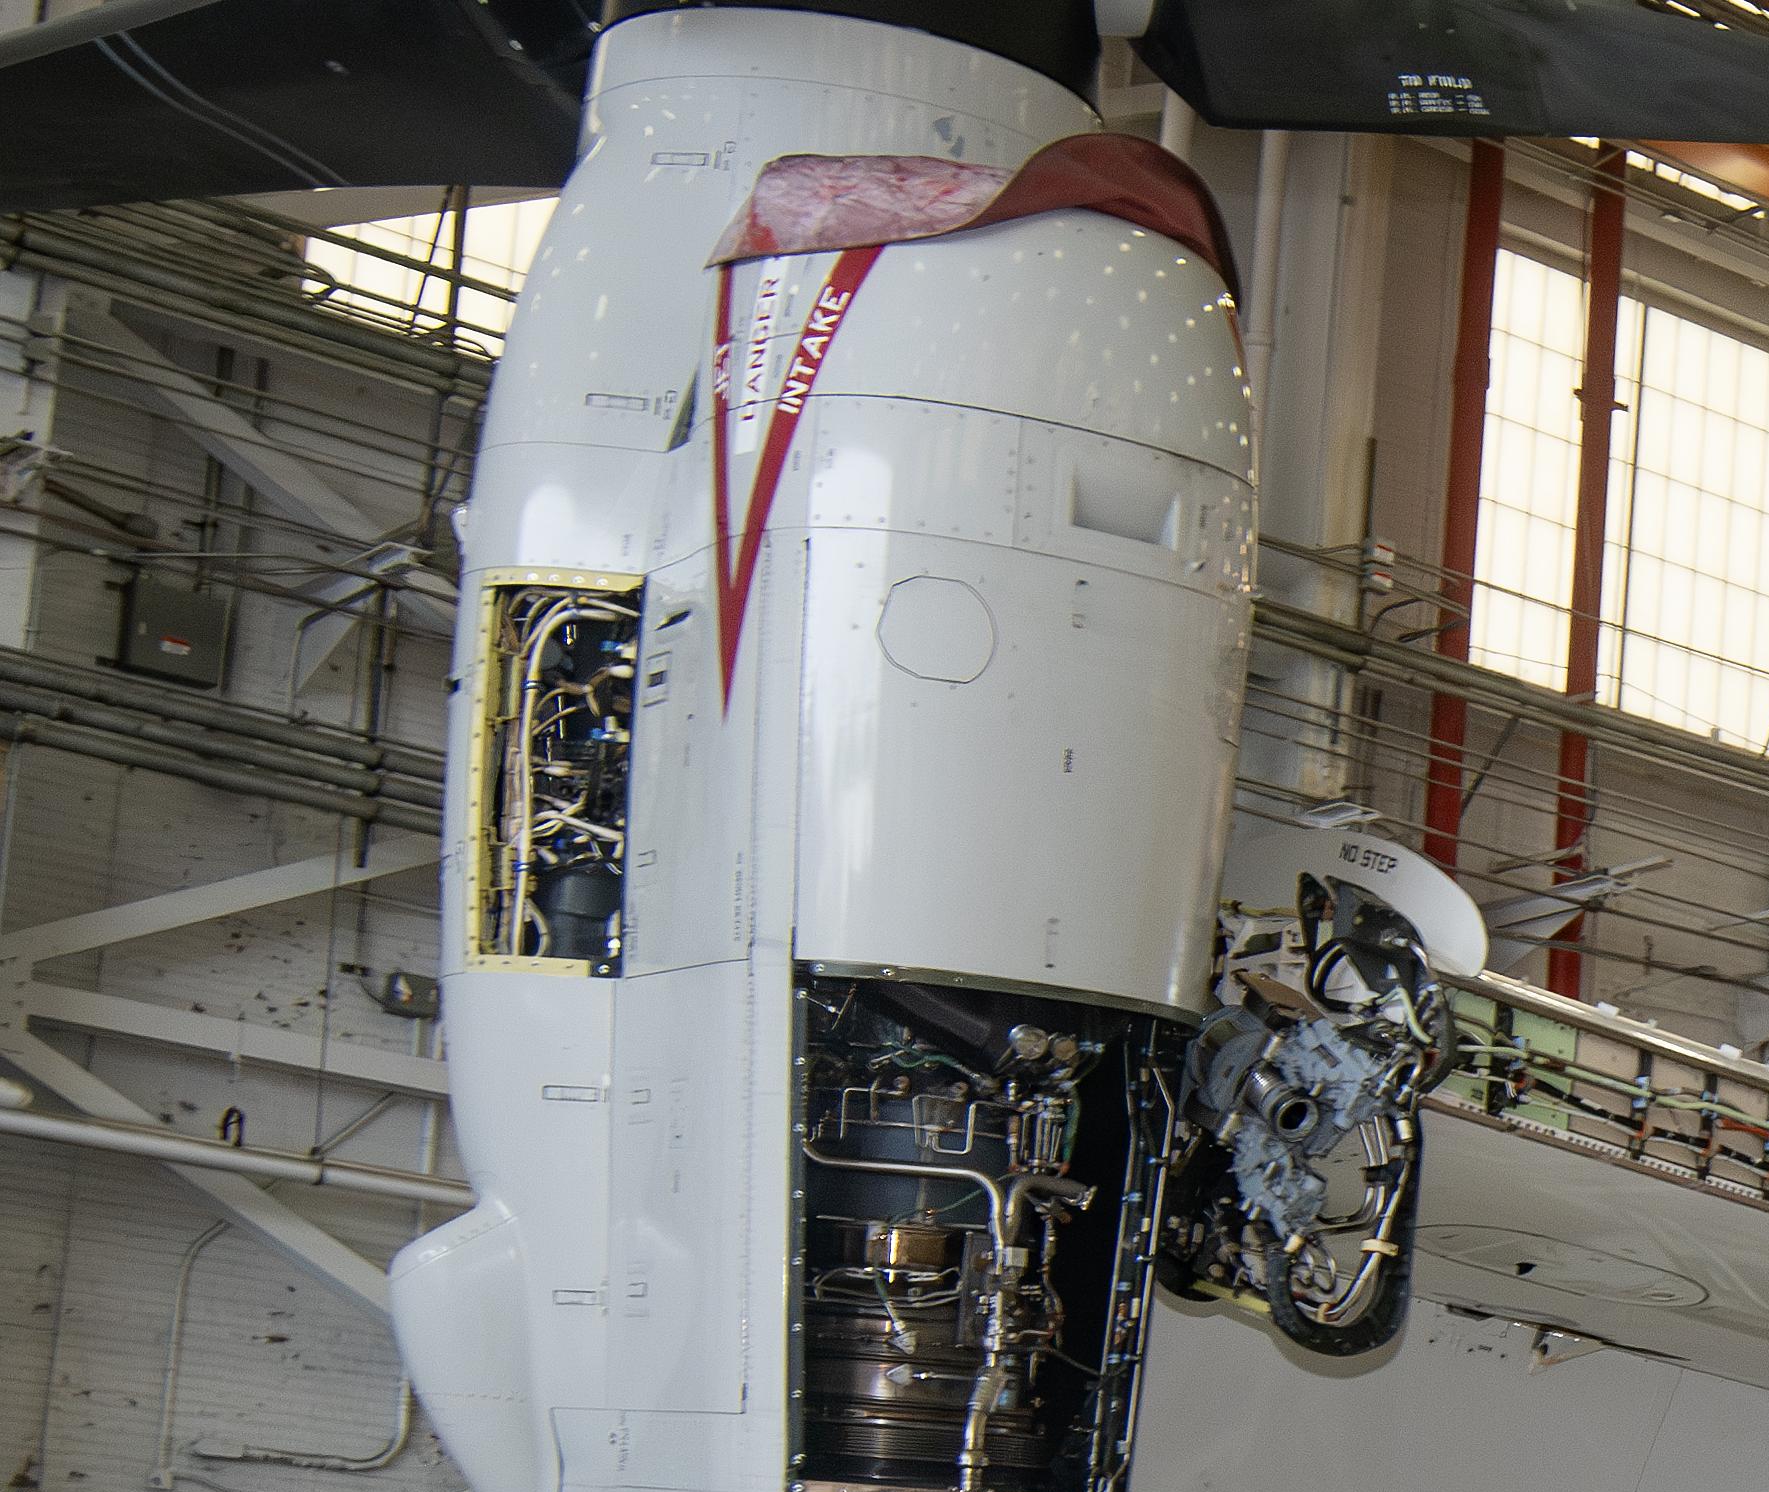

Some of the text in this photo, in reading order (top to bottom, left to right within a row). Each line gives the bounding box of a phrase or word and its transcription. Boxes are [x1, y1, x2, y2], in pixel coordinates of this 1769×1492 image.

[777, 285, 852, 415] INTAKE
[1338, 842, 1398, 874] NO STEP
